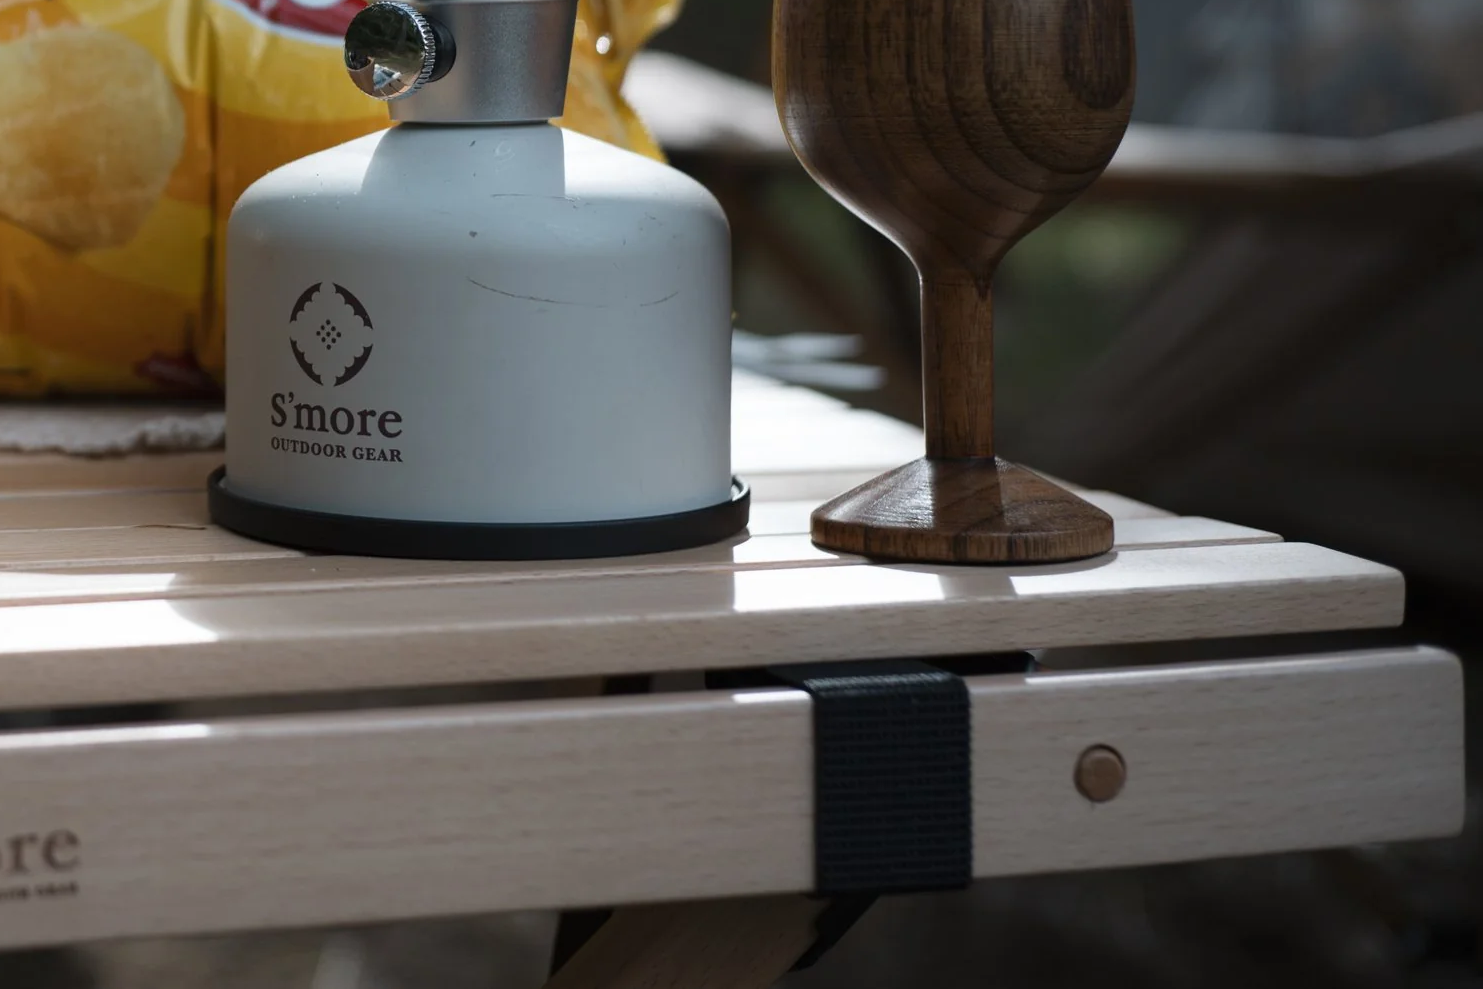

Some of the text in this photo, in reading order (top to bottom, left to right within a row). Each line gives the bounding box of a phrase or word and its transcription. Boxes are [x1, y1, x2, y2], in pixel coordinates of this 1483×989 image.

[271, 391, 403, 439] S'more
[270, 436, 404, 463] OUTDOOR GEAR
